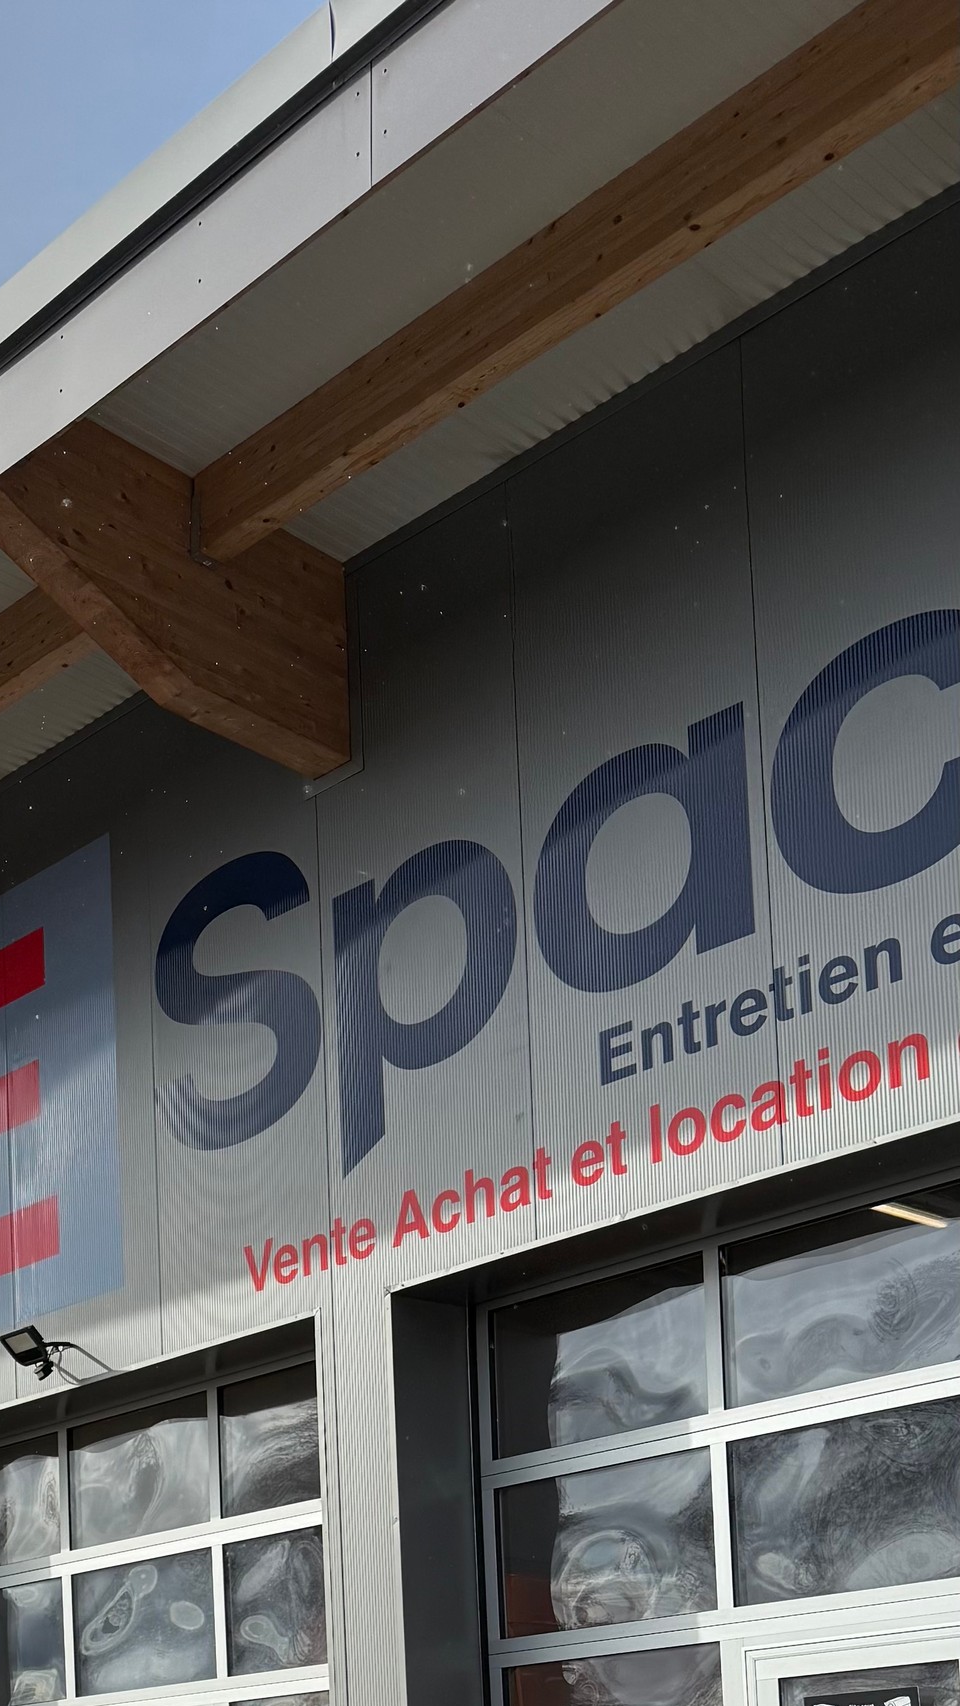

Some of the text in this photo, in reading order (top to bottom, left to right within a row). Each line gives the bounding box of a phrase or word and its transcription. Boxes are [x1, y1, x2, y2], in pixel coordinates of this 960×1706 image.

[599, 929, 905, 1086] Entretien
[243, 1032, 931, 1293] Vente Achat et location
